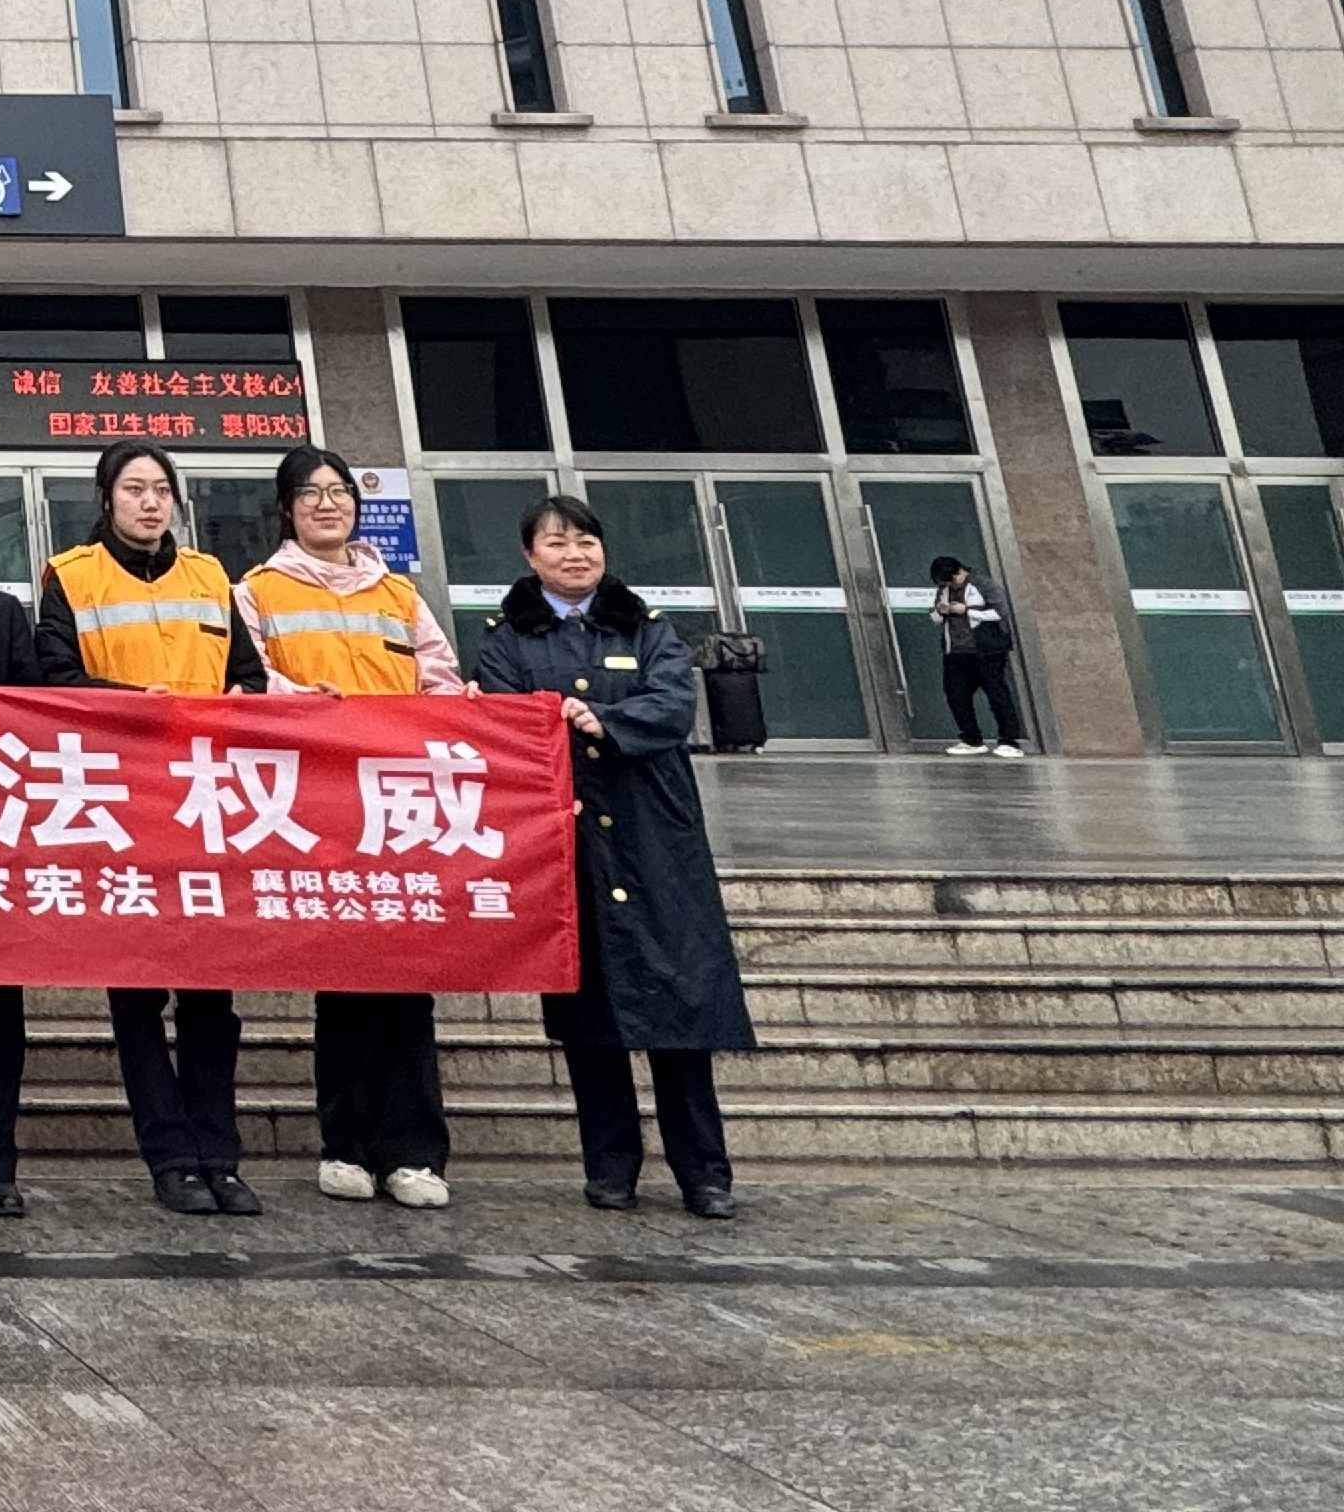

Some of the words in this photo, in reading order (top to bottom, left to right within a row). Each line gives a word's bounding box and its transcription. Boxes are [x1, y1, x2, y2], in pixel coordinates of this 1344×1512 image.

[13, 370, 62, 396] 诚信
[250, 868, 443, 896] 襄阳铁检院
[254, 895, 447, 923] 襄铁公安处
[465, 877, 516, 920] 宣
